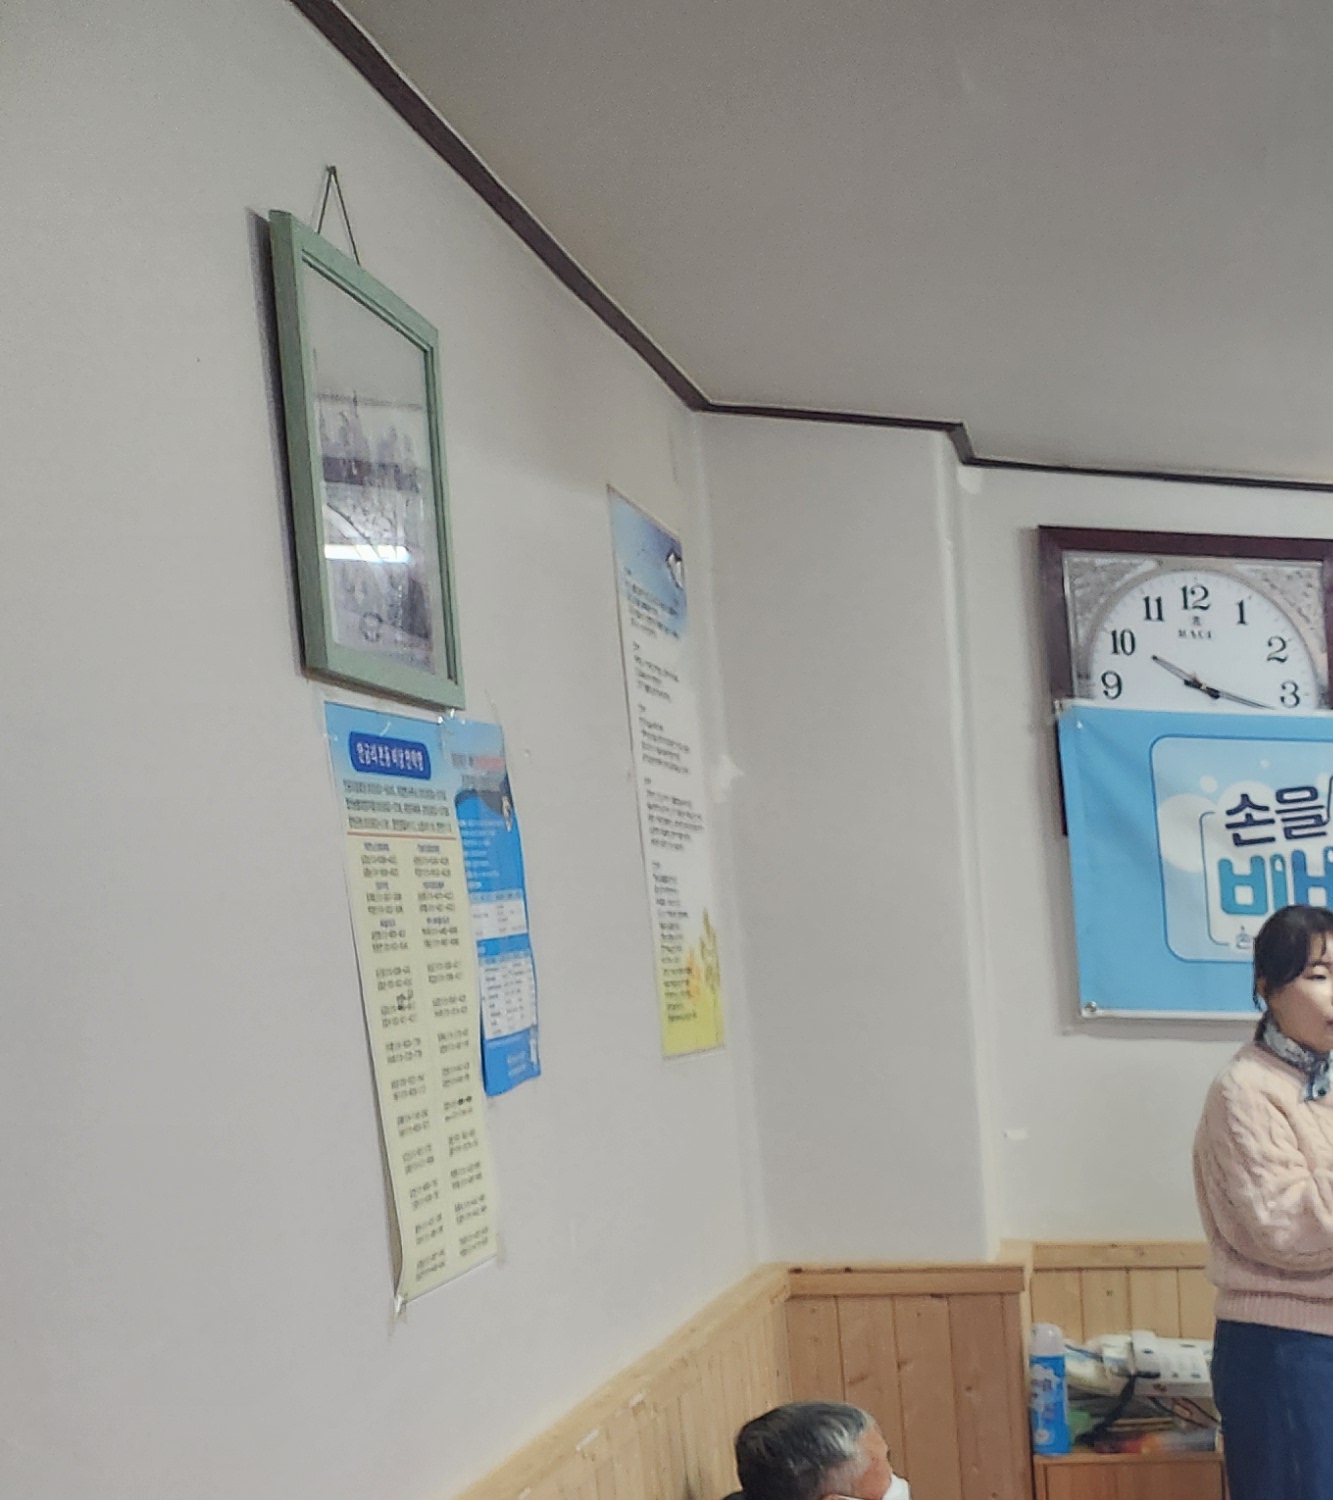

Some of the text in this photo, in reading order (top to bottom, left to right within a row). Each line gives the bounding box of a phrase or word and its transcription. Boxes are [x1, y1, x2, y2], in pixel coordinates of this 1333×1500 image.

[1143, 596, 1164, 622] 11
[1181, 585, 1211, 611] 12
[1236, 600, 1248, 625] 1
[1111, 628, 1136, 656] 10
[1266, 635, 1288, 664] 2
[1101, 670, 1123, 700] 9
[1280, 680, 1301, 709] 3
[1225, 786, 1329, 847] 손을
